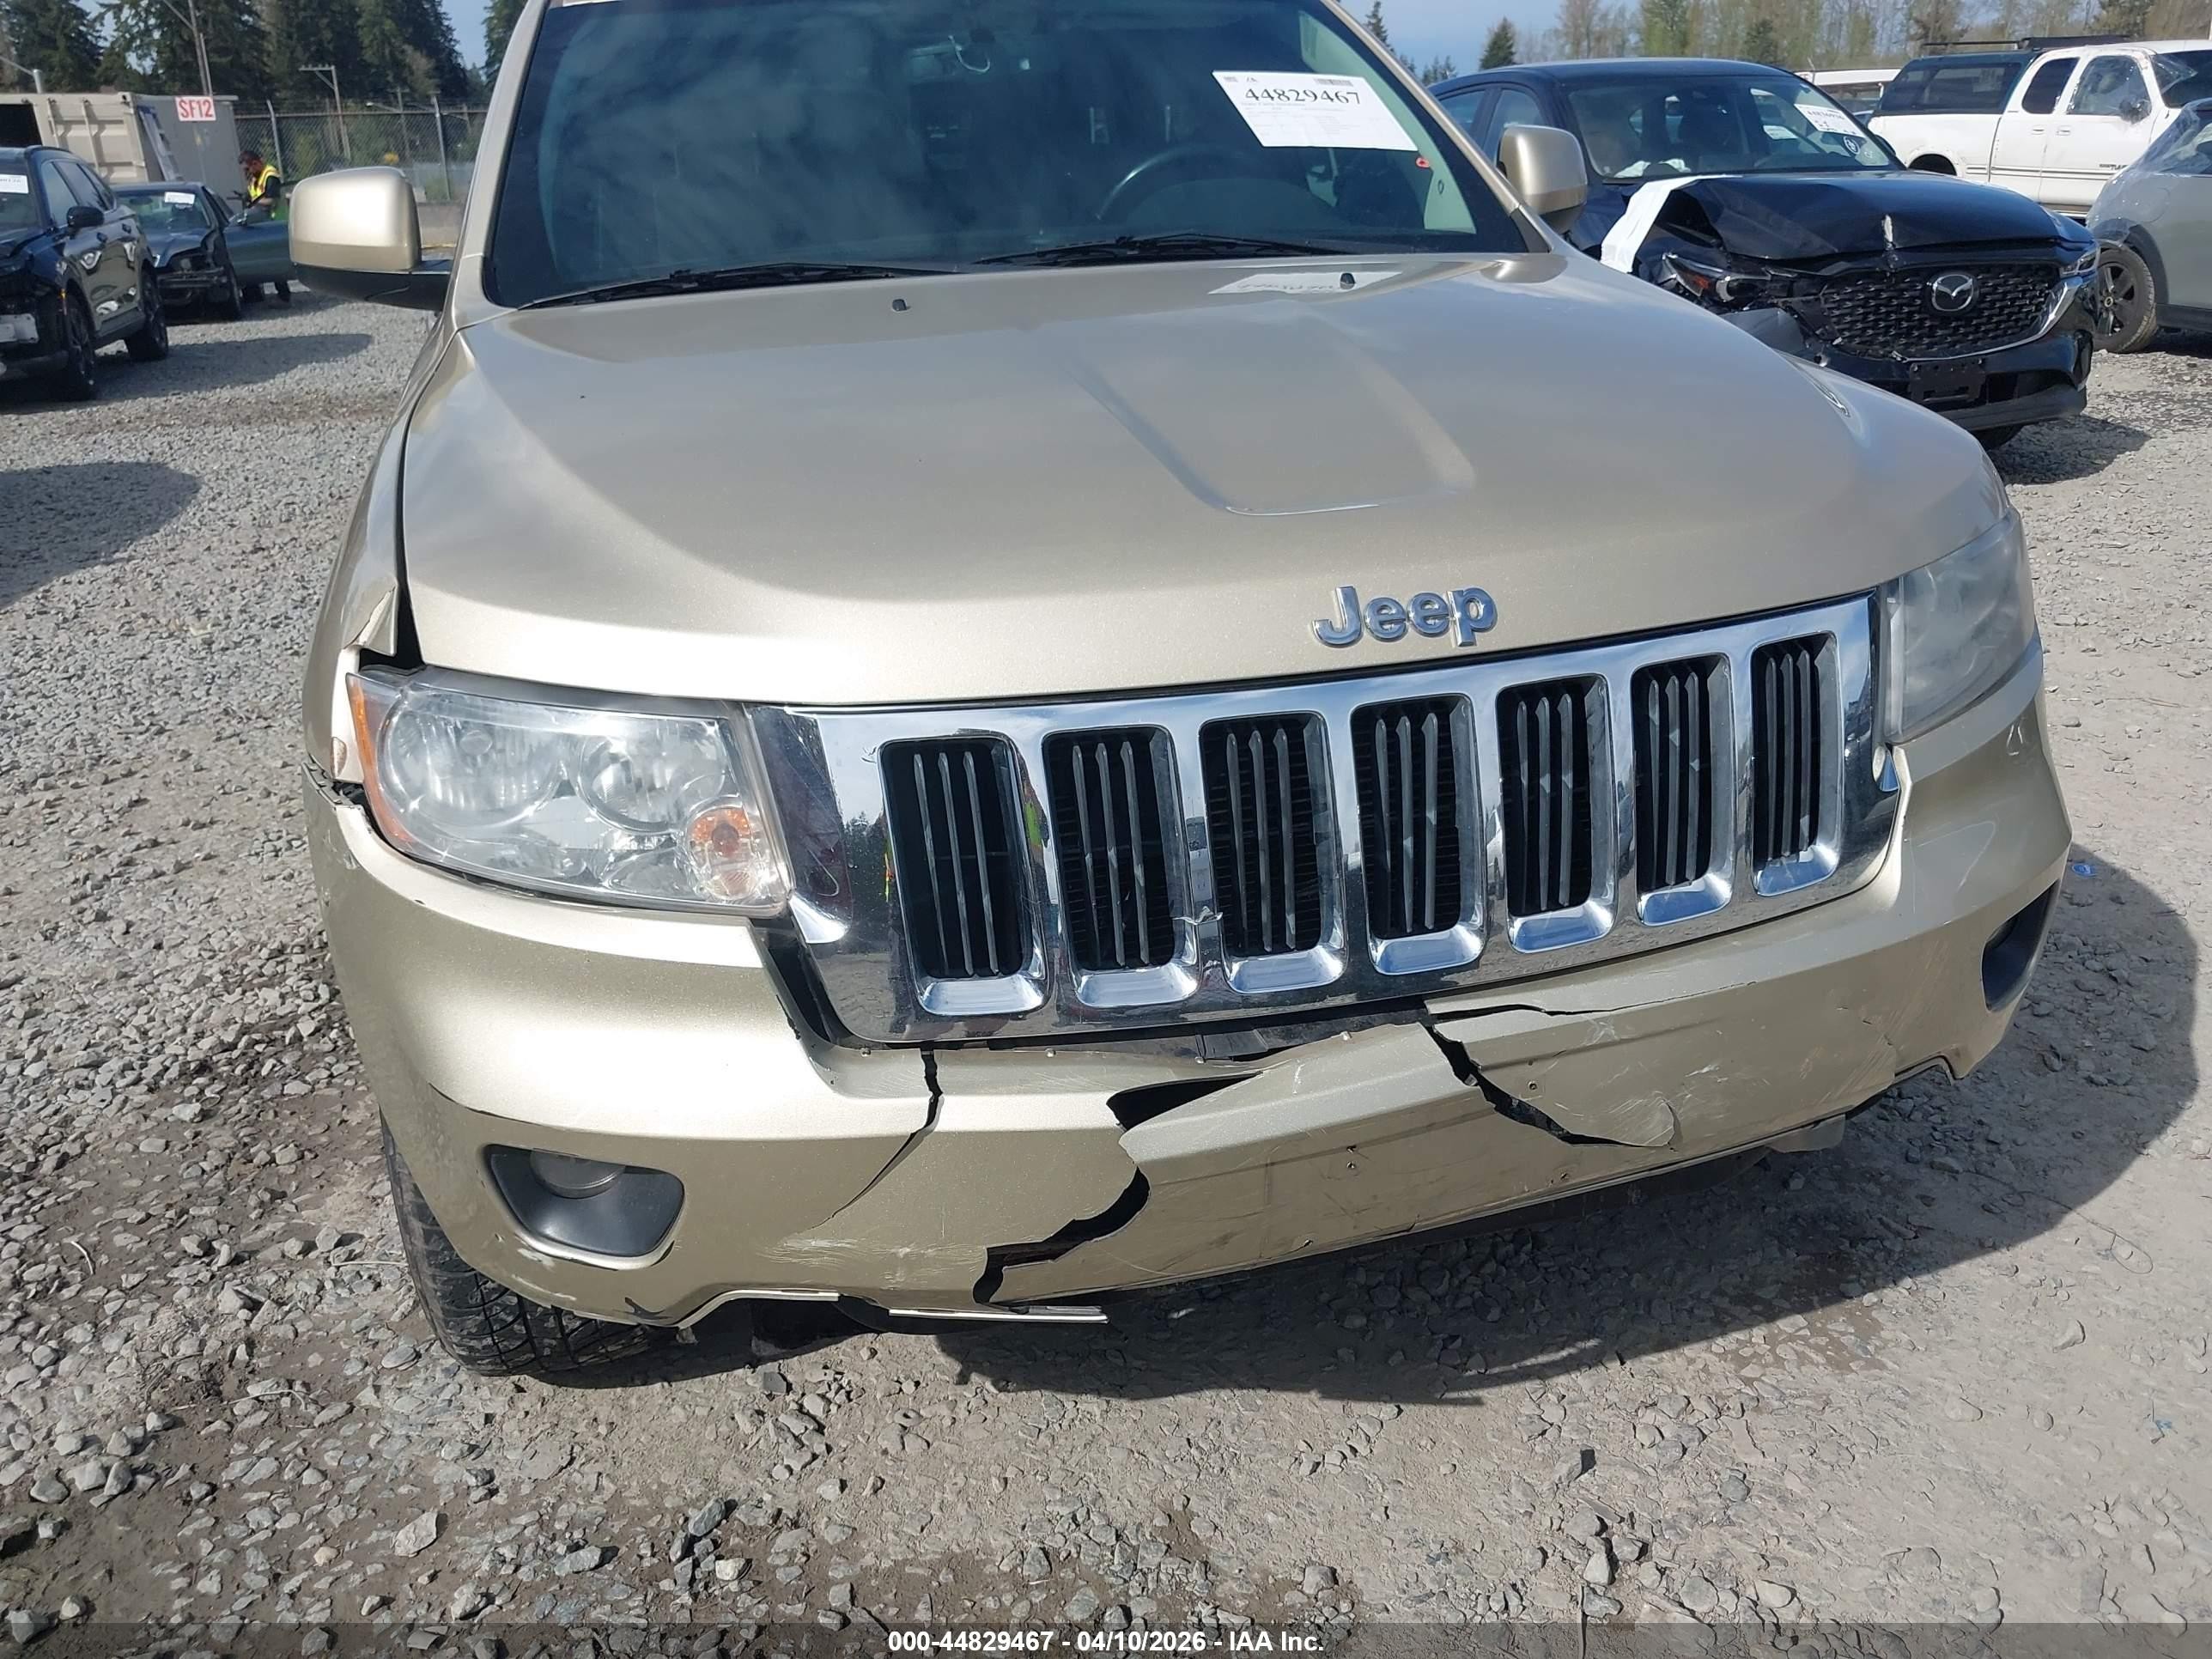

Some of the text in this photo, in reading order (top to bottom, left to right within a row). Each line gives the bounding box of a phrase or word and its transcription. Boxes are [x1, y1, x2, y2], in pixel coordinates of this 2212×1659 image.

[1244, 88, 1361, 106] 44829467
[178, 99, 214, 118] SF12
[1311, 586, 1498, 649] Jeep
